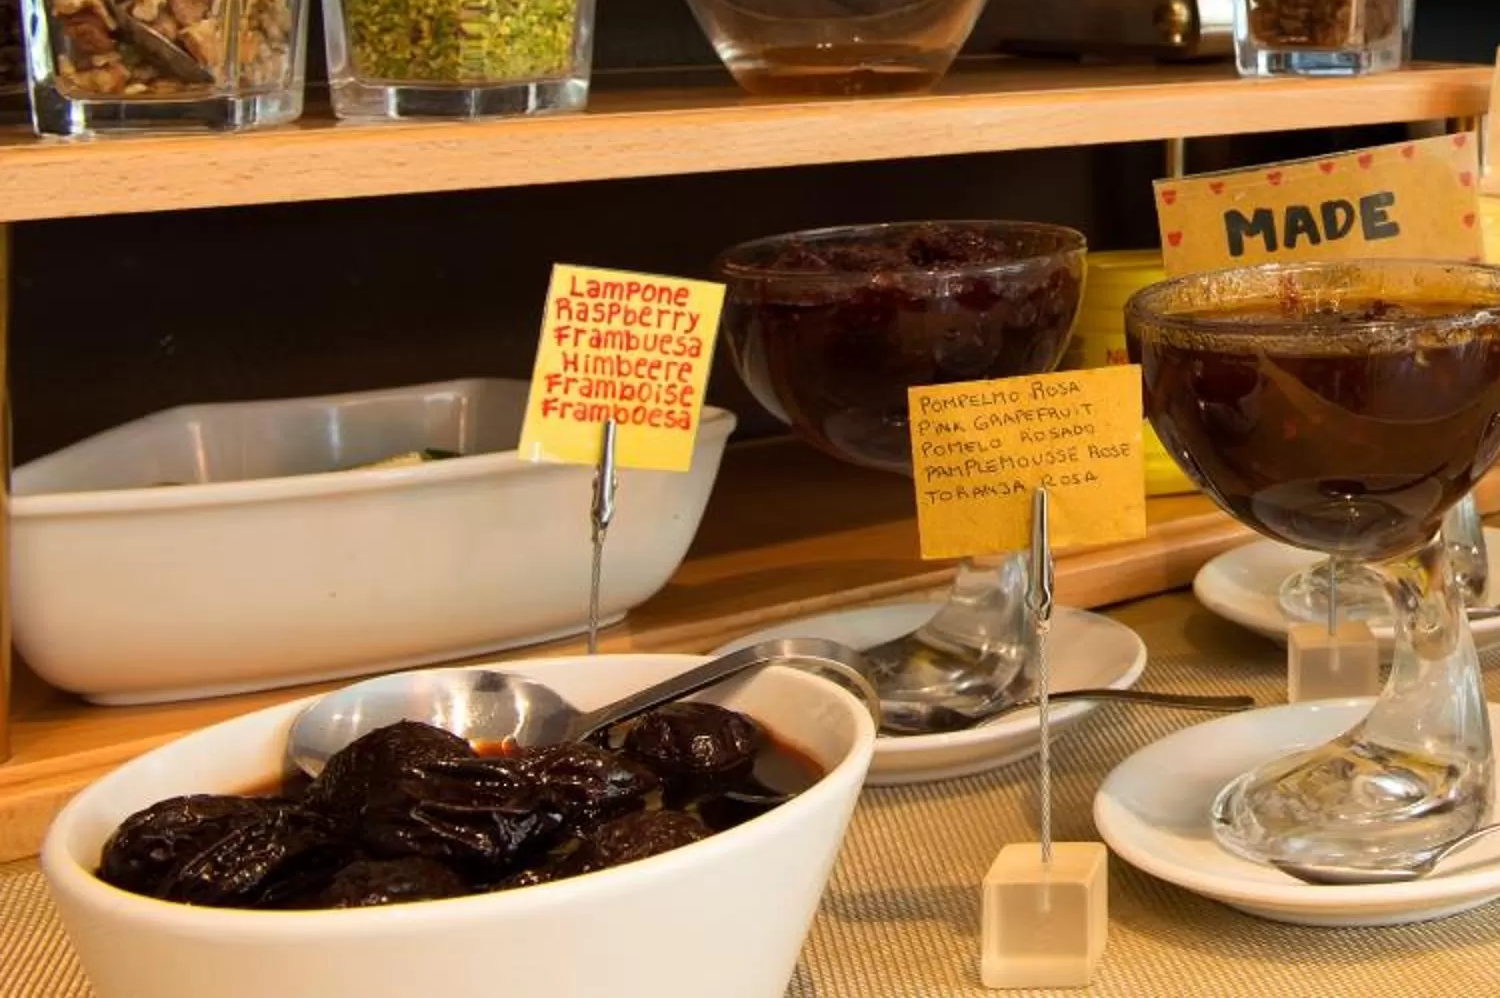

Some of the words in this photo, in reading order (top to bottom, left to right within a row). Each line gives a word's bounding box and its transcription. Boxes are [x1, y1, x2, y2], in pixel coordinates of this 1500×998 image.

[1223, 190, 1401, 258] MADE
[552, 325, 703, 359] Frambuesa
[561, 351, 693, 383] Himbeere
[543, 373, 696, 407] Framboise
[919, 390, 1020, 415] POMPELMO
[1030, 380, 1082, 401] ROSA
[541, 397, 692, 431] Framboesa
[920, 438, 1003, 459] POMELO
[1020, 423, 1096, 445] ROSADO
[924, 446, 1081, 483] PAMPLEMOUSSE
[1087, 443, 1133, 459] ROSE
[923, 479, 1027, 506] TORANJA
[1040, 470, 1100, 489] ROSA
